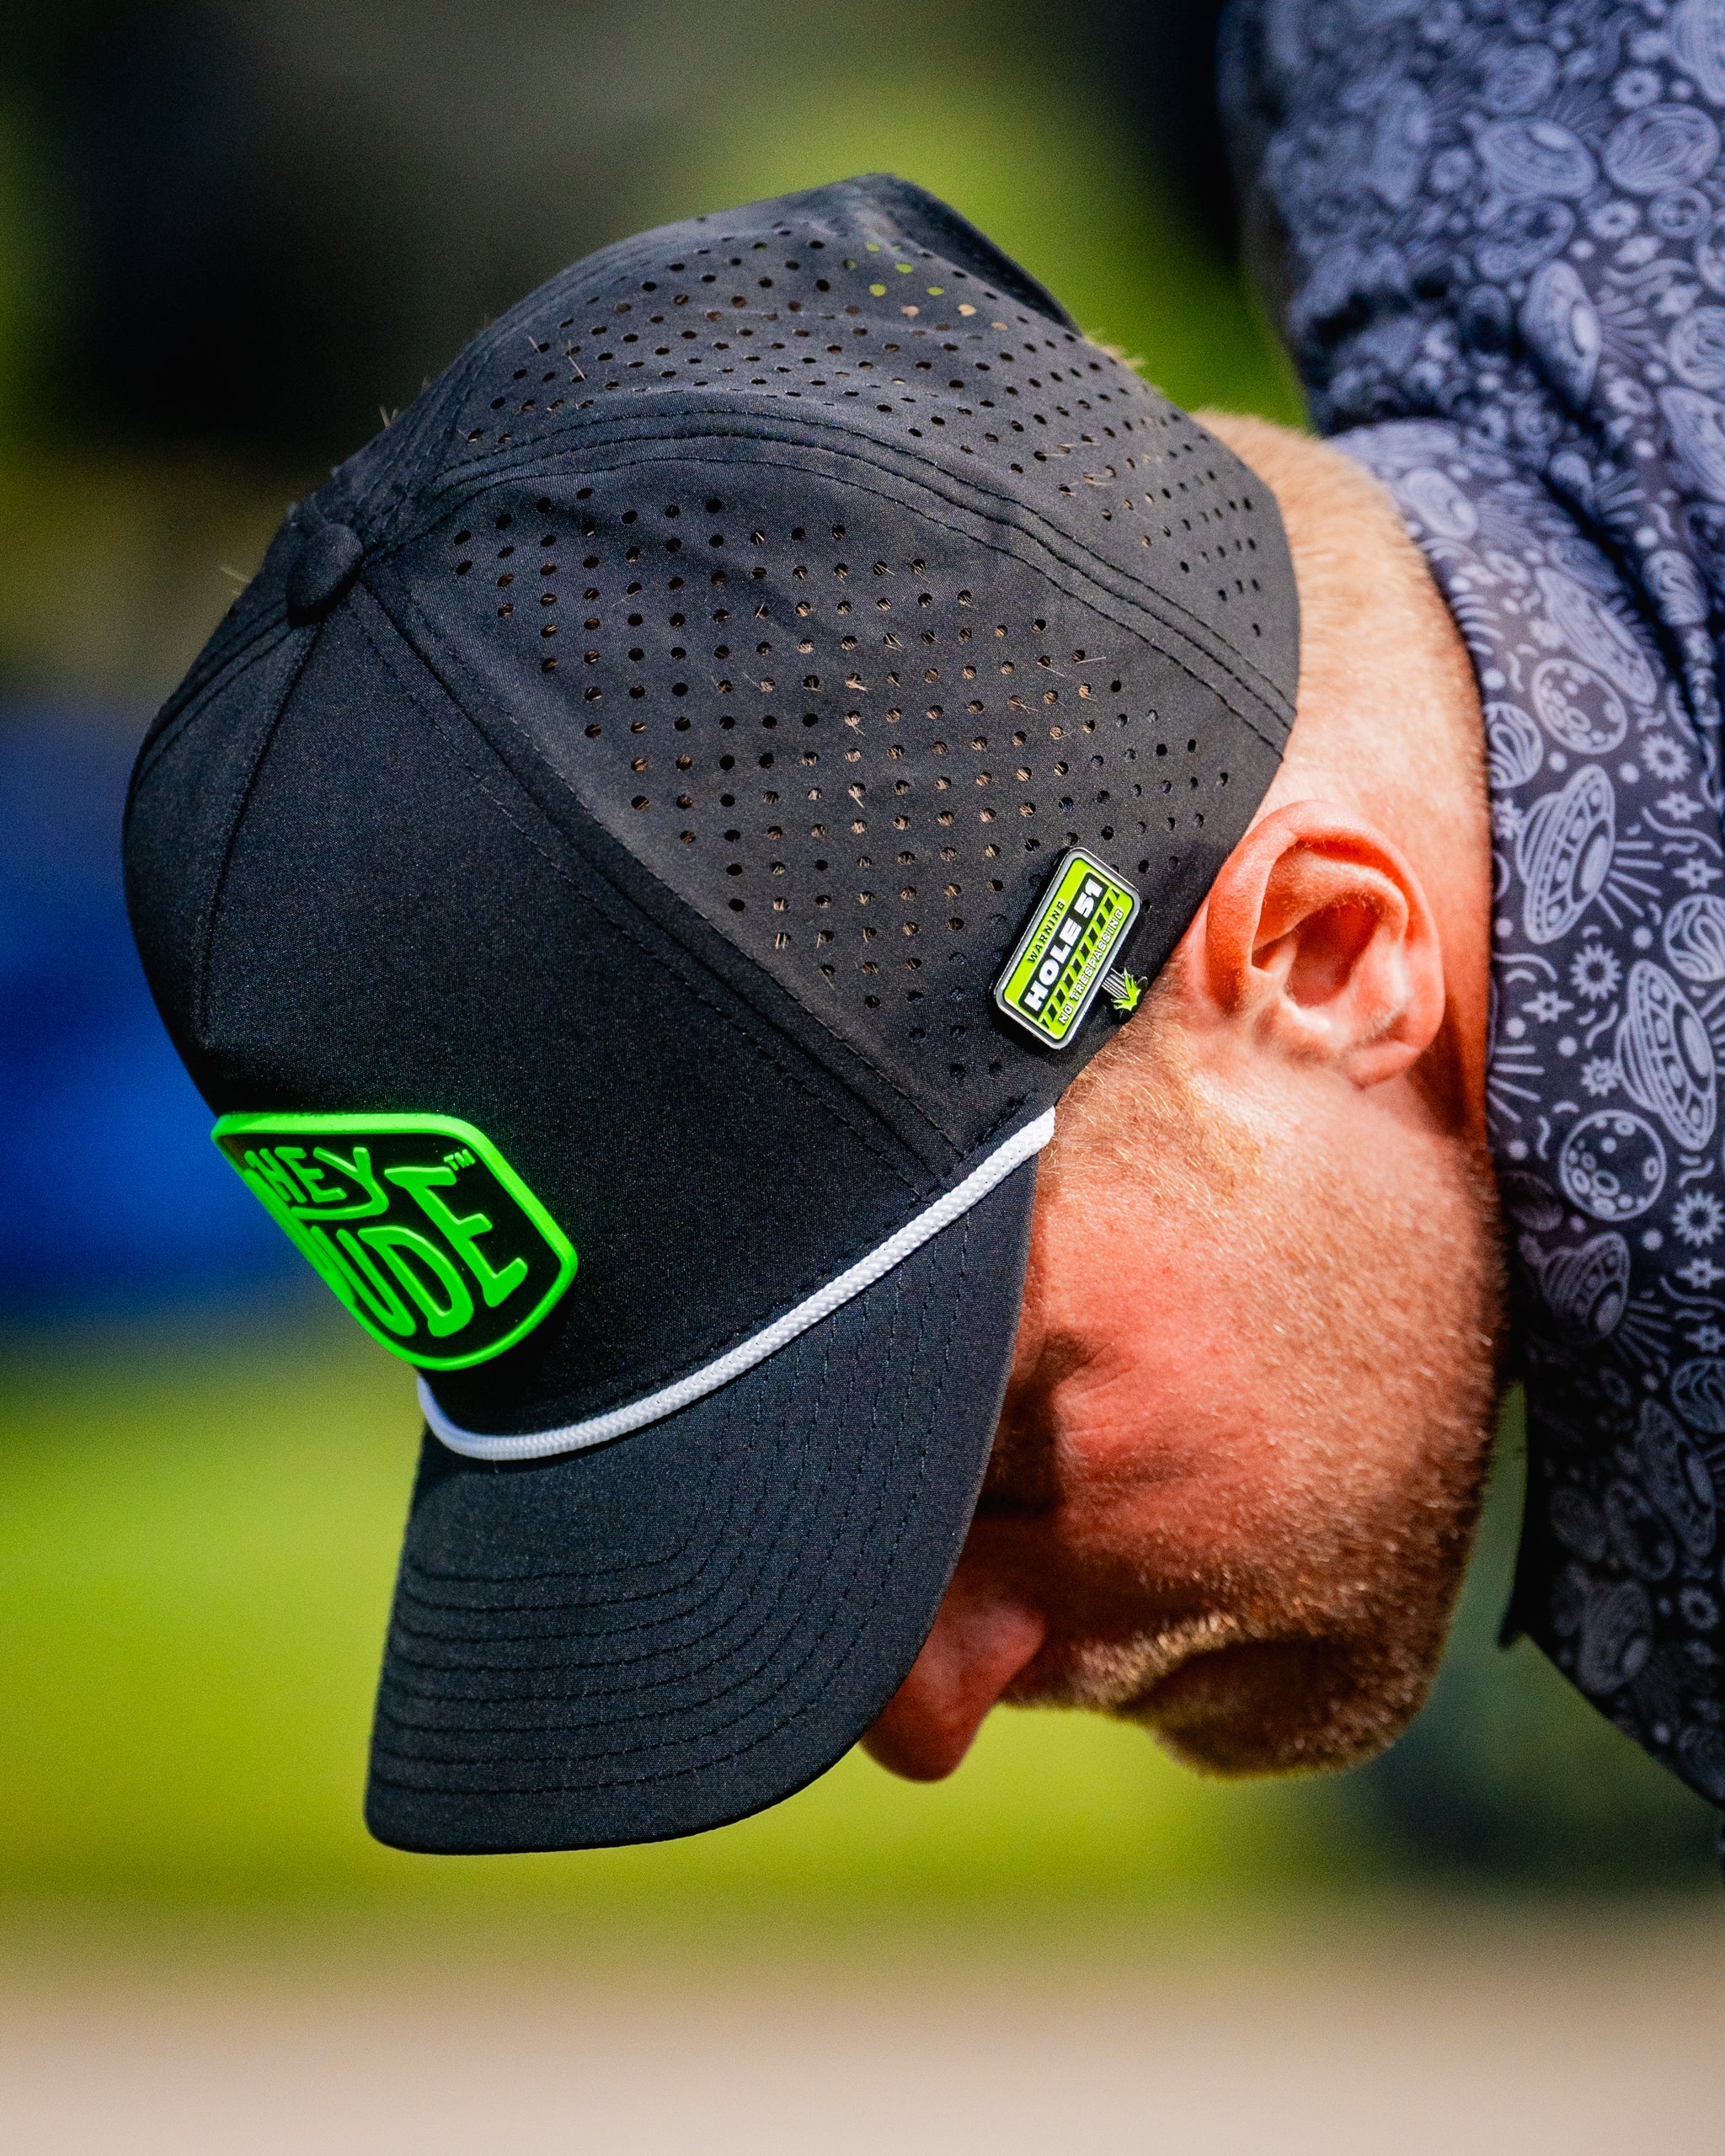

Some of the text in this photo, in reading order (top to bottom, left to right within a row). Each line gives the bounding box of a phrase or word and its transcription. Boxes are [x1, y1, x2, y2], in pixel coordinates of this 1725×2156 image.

[1023, 878, 1103, 1011] HOLE 51
[1027, 898, 1065, 963] WARNING
[1058, 909, 1124, 1025] NO TRESPASSING
[244, 1146, 389, 1220] HEY
